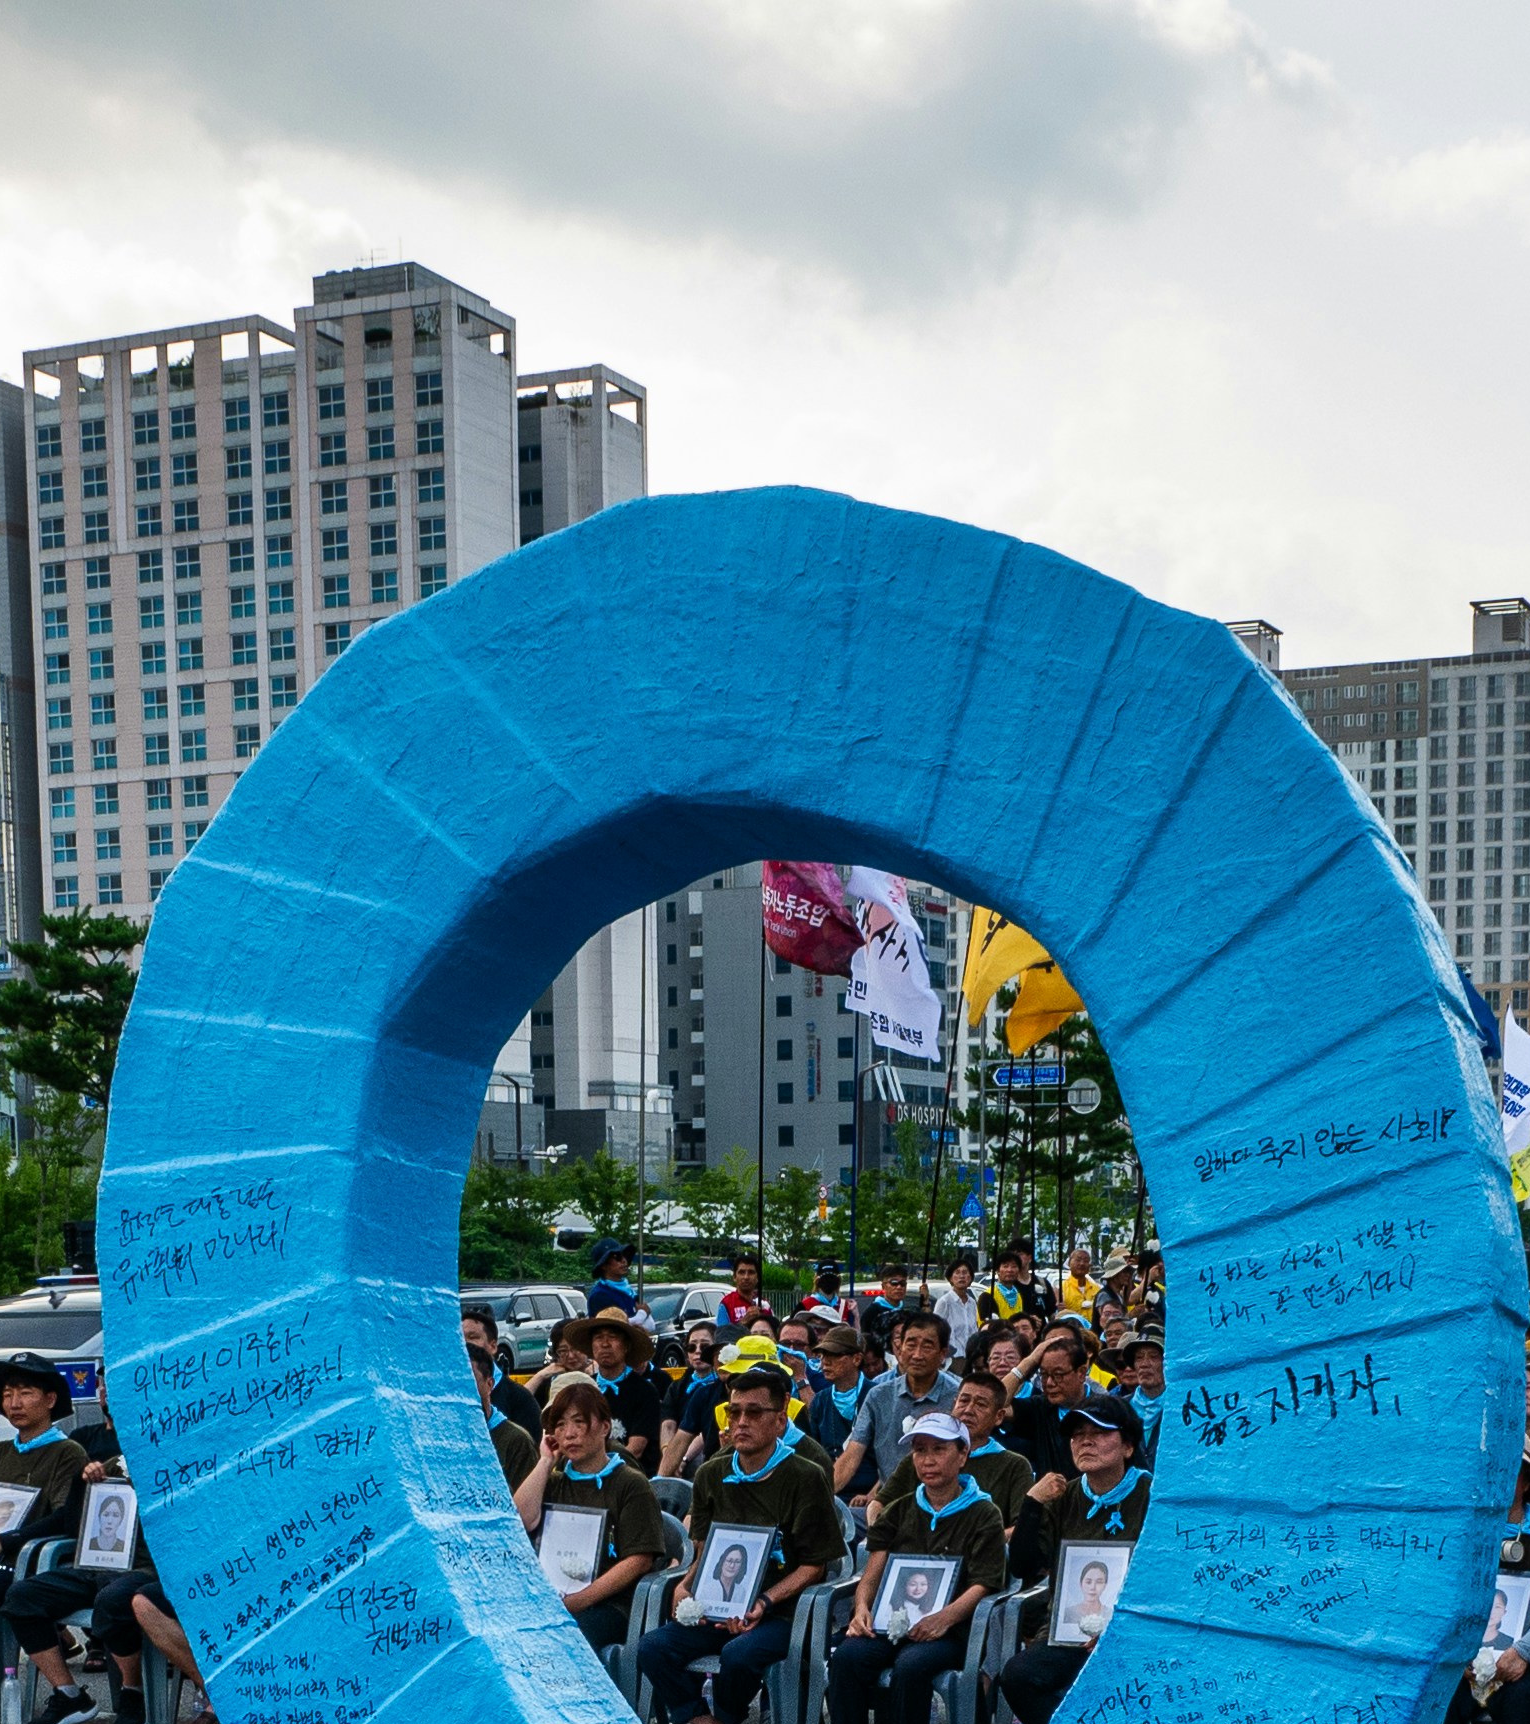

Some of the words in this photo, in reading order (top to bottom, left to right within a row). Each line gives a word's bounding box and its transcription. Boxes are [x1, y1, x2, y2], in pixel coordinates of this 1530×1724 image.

[897, 1104, 910, 1122] DS
[1194, 1147, 1251, 1183] 일하다
[1254, 1133, 1307, 1169] 죽지
[1279, 1238, 1345, 1271] 사람이
[1180, 1385, 1261, 1447] 삶을
[185, 1568, 221, 1601] 이윤
[220, 1546, 258, 1587] 보다
[265, 1518, 319, 1559] 생명이
[319, 1474, 385, 1525] 우선이다
[1174, 1519, 1266, 1553] 노동자의
[1279, 1524, 1340, 1559] 죽음을
[1192, 1559, 1238, 1589] 위험의
[1248, 1583, 1295, 1615] 죽음의
[1234, 1669, 1259, 1686] 가서
